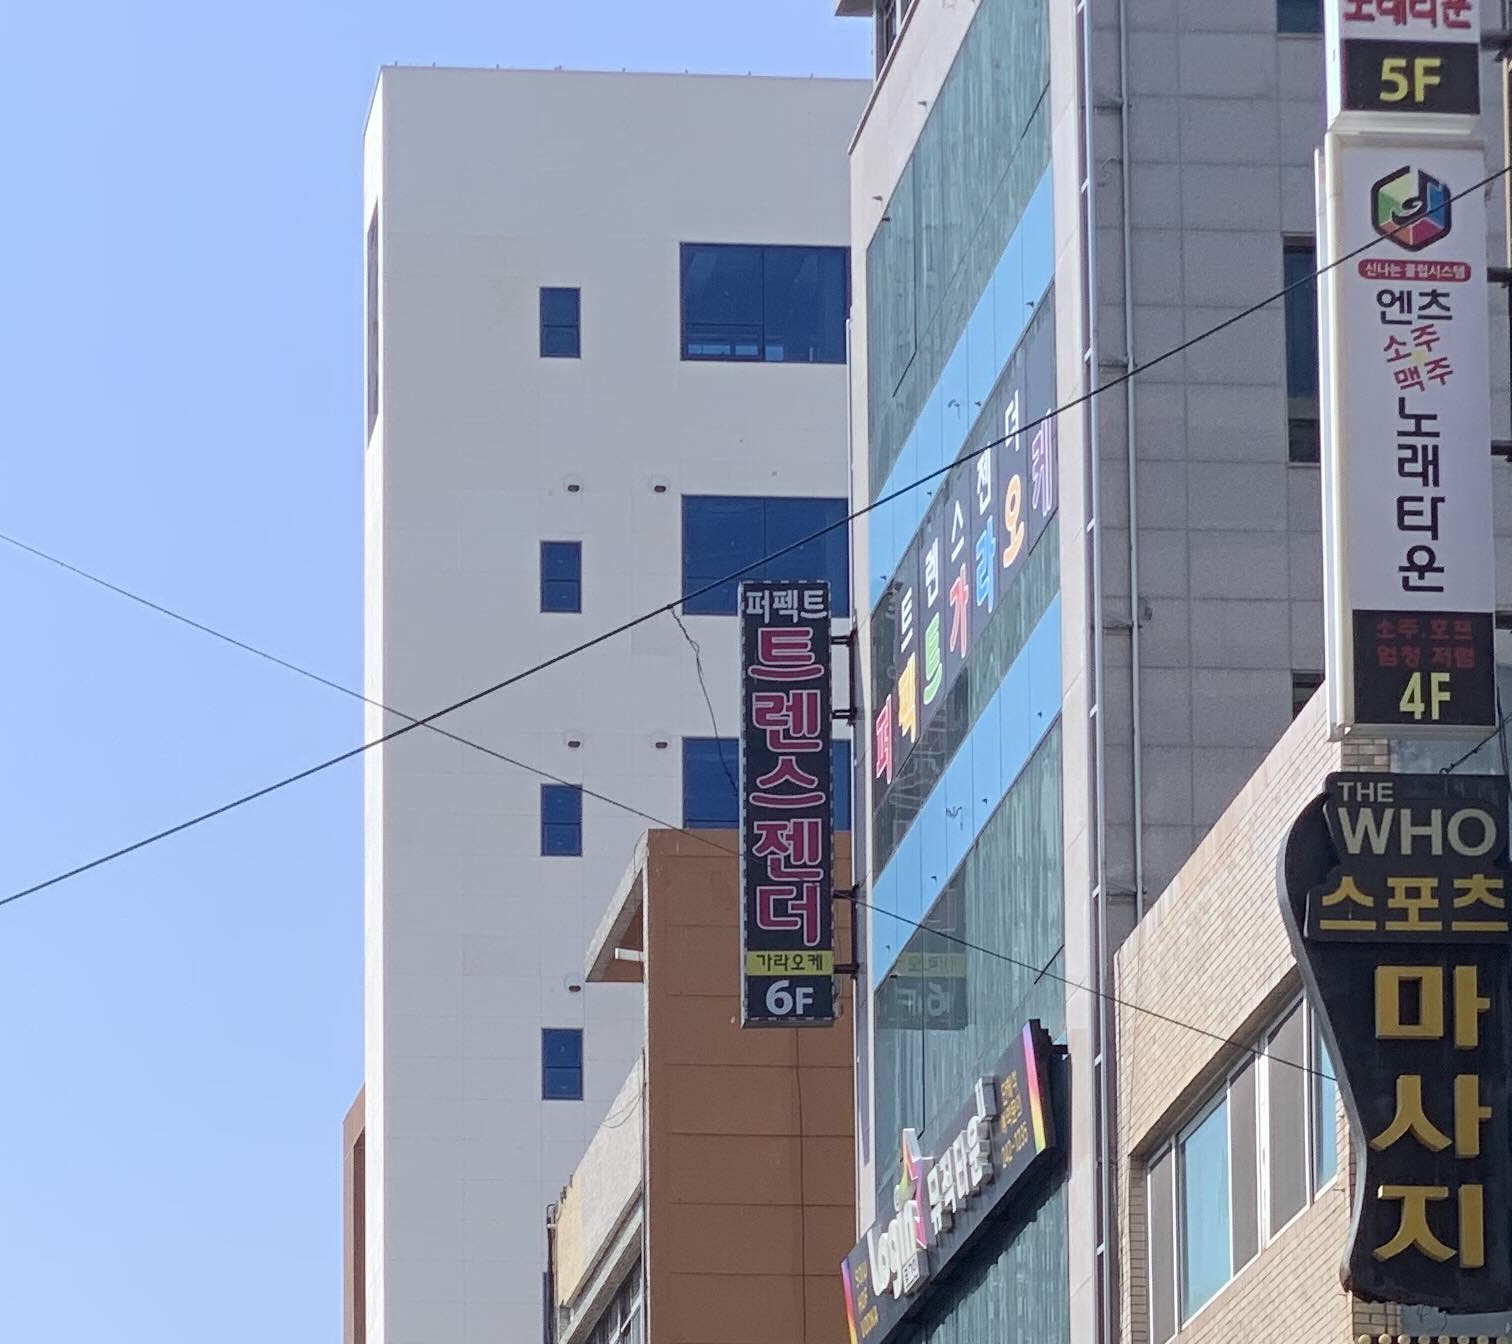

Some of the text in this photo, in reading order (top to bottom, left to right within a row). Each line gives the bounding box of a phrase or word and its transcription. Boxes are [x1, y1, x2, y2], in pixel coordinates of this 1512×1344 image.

[1378, 57, 1443, 104] 5F
[1364, 261, 1405, 279] 신나는
[1376, 288, 1454, 327] 엔츠
[1395, 396, 1447, 594] 노래타운
[745, 588, 828, 624] 퍼펙트
[1398, 671, 1452, 721] 4F
[747, 626, 826, 947] 트렌스젠더
[1337, 781, 1395, 803] THE
[1337, 807, 1497, 857] WHO
[1319, 874, 1509, 932] 스포츠
[755, 953, 825, 973] 가라오케
[764, 979, 815, 1017] 6F
[1369, 964, 1493, 1269] 마사지
